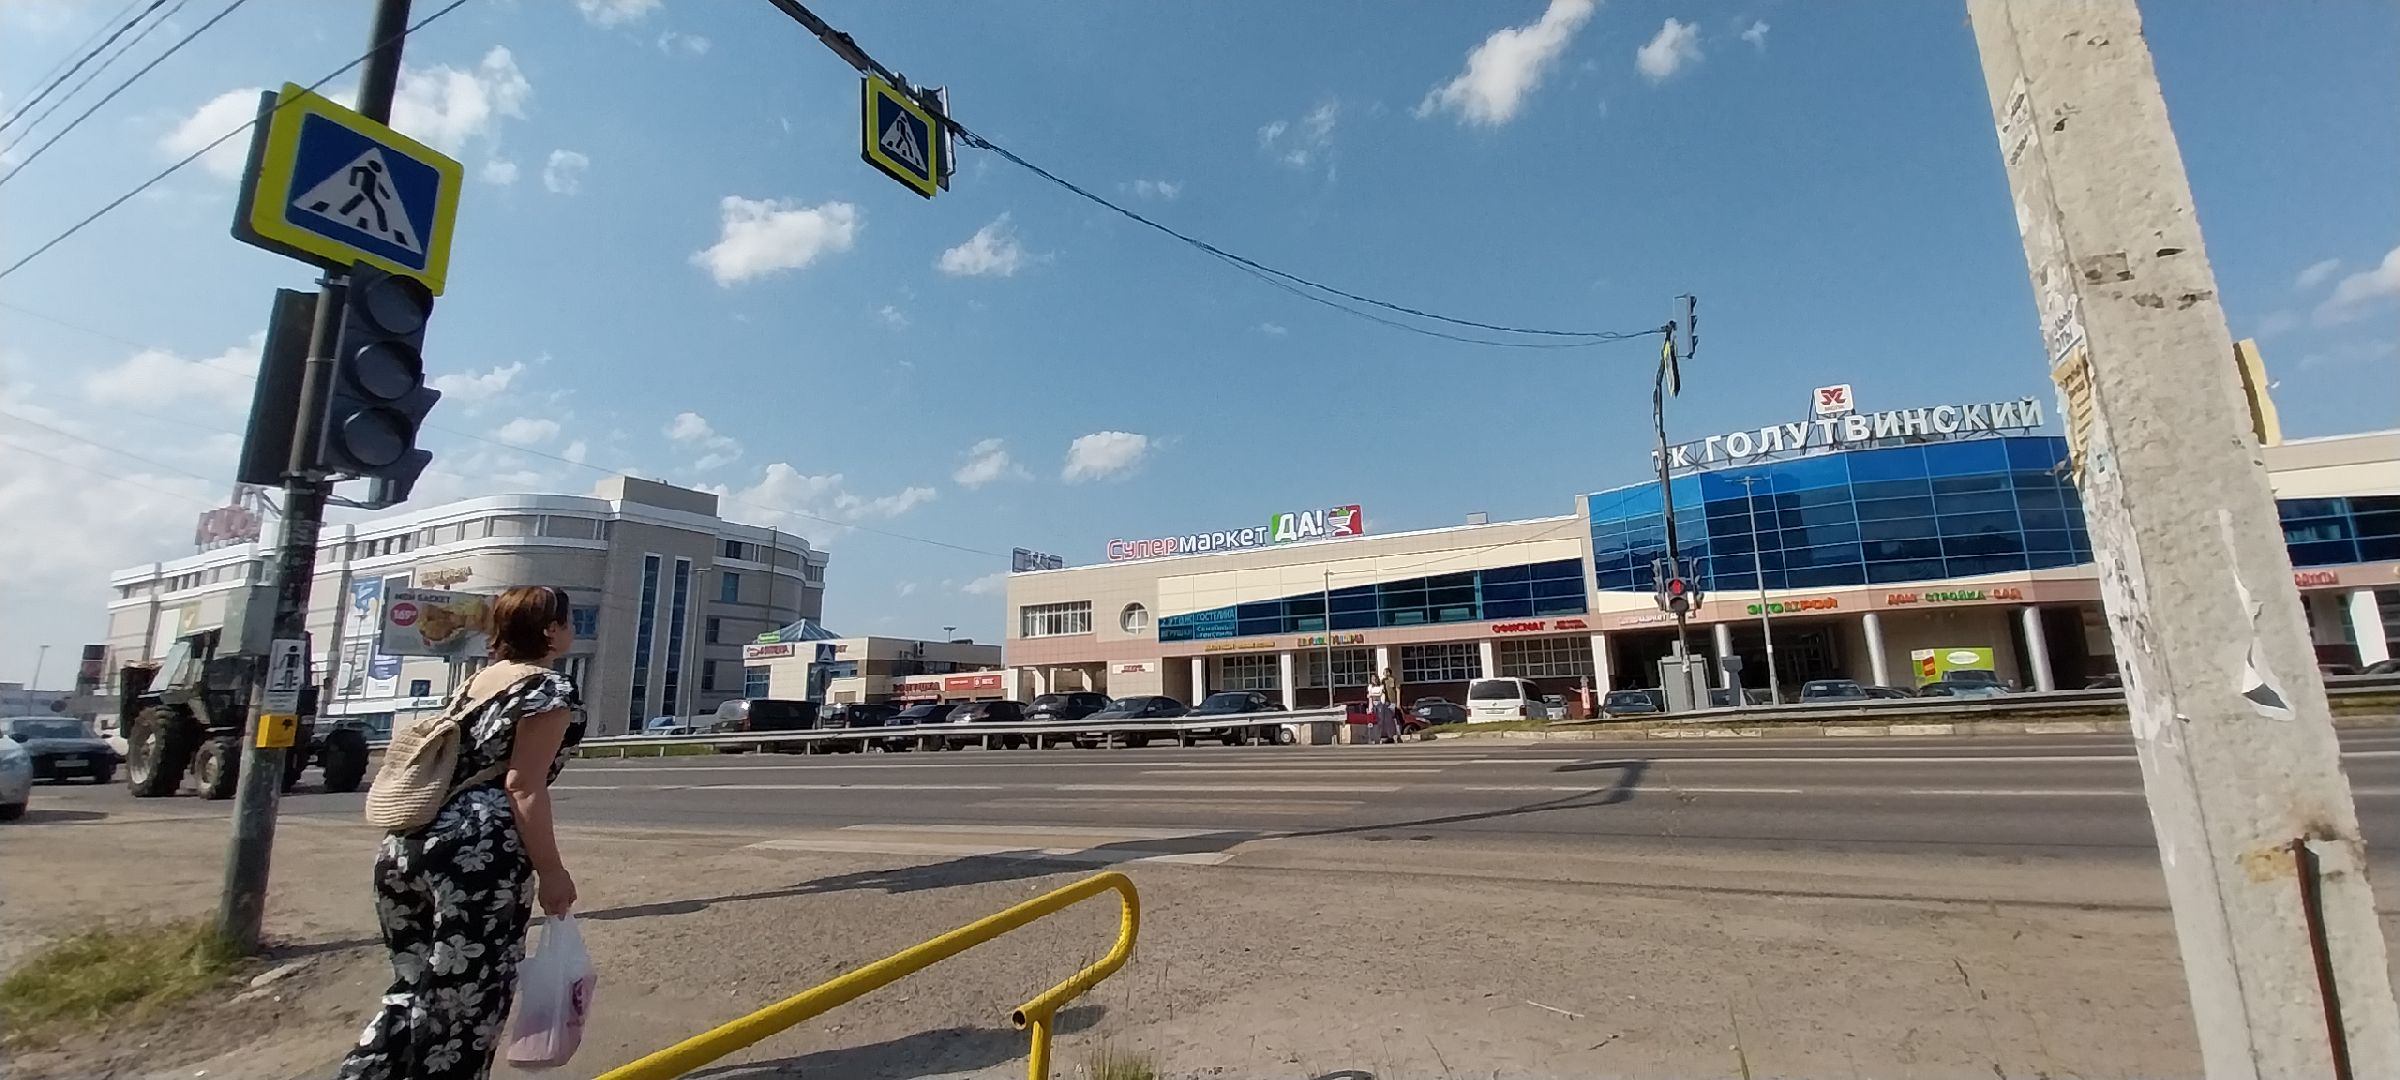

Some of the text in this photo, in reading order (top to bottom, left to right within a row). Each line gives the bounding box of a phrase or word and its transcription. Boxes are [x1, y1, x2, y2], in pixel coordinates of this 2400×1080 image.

[1706, 396, 2044, 462] ГОЛУТВИНСКИЙ
[1107, 509, 1324, 560] Супермаркет ДА!
